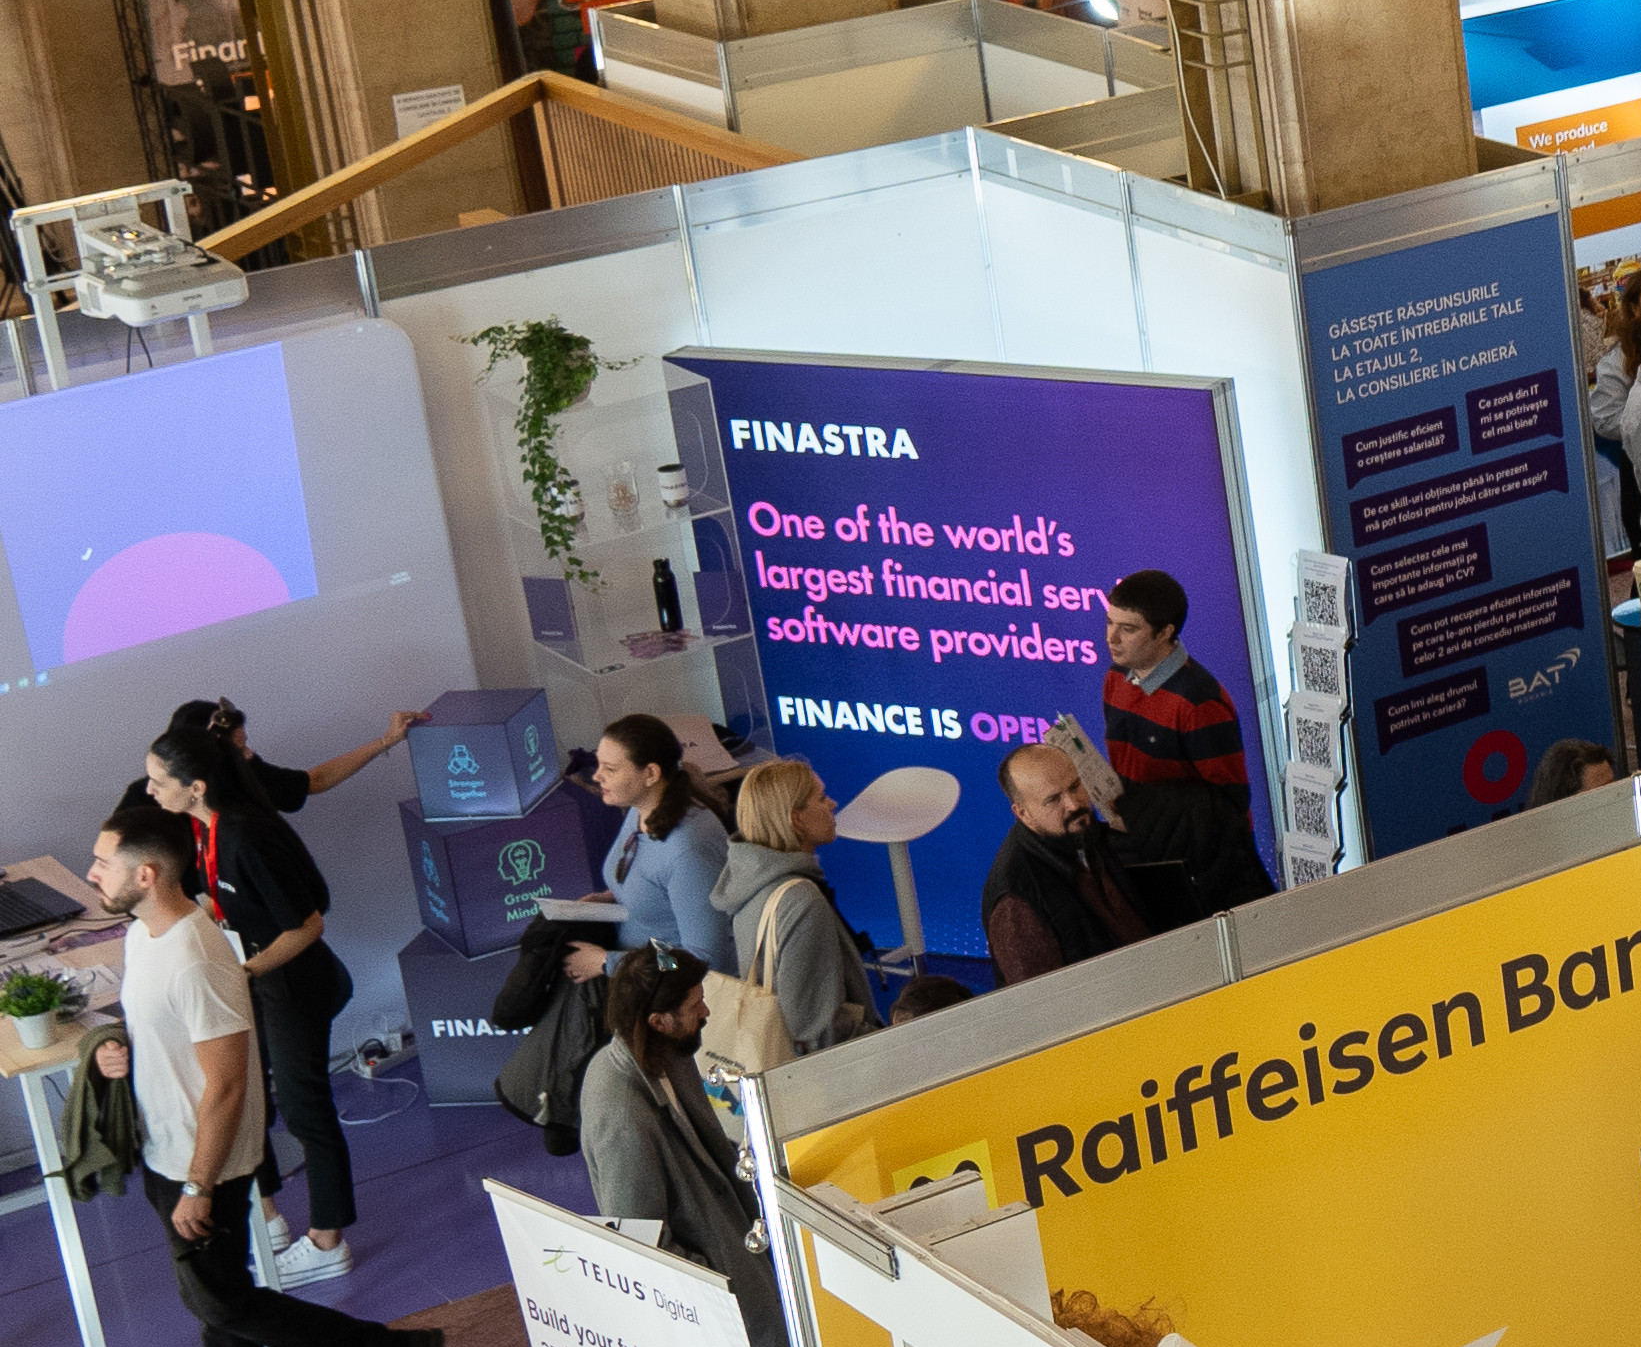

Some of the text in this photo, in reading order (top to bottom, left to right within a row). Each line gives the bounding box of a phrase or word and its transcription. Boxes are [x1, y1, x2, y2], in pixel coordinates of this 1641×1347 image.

[1529, 132, 1553, 149] We
[1555, 119, 1608, 143] produce
[1397, 282, 1500, 321] RĂSPUNSURILE
[1331, 298, 1524, 361] LA TOATE ÎNTREBĂRILE TALE
[1334, 348, 1423, 383] LA ETAJUL 2,
[1336, 340, 1518, 405] LA CONSILIERE ÎN CARIERĂ
[1530, 384, 1540, 396] IT
[730, 419, 920, 460] FINASTRA
[1355, 420, 1444, 453] Cum justific eficient
[748, 501, 1075, 557] One of the world's
[1382, 517, 1398, 531] pot
[1454, 495, 1477, 513] jobul
[755, 550, 1033, 607] largest financial
[1370, 562, 1393, 576] Cum
[1456, 566, 1476, 582] CV?
[767, 606, 1098, 665] software providers
[1410, 622, 1434, 636] Cum
[1508, 662, 1567, 700] BAT
[777, 696, 963, 739] FINANCE IS
[1388, 704, 1411, 718] Cum
[503, 883, 553, 906] Growth
[1016, 992, 1486, 1209] Raiffeisen
[578, 1256, 701, 1326] TELUS Digital
[526, 1297, 571, 1336] Build
